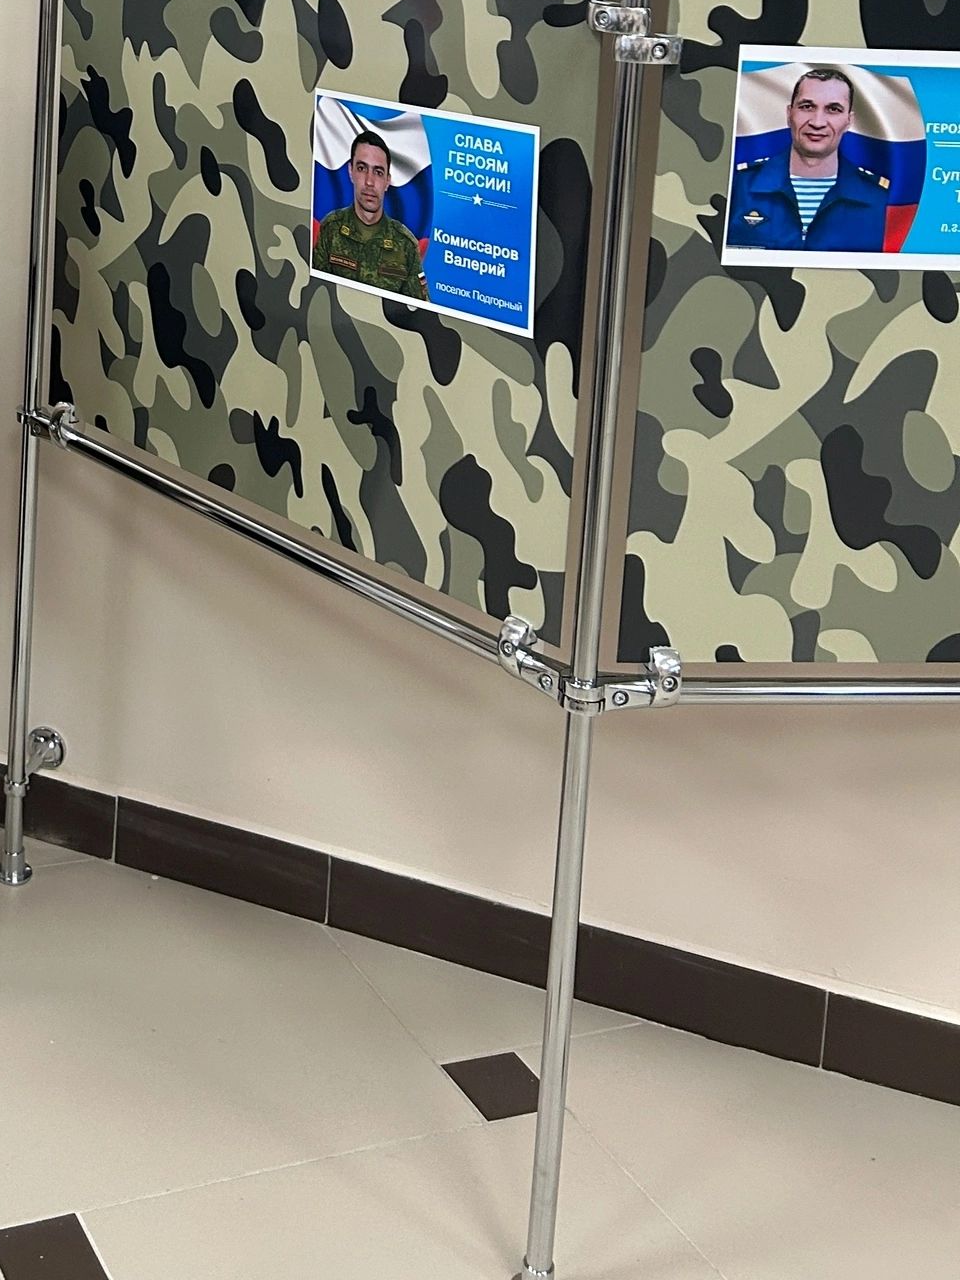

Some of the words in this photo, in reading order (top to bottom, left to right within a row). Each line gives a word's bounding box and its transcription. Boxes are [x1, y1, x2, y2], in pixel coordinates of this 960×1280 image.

[454, 133, 503, 155] СЛАВА
[448, 150, 509, 174] ГЕРОЯМ
[444, 167, 511, 194] РОССИИ!
[433, 227, 520, 261] Комиссаров
[443, 250, 506, 278] Валерий
[435, 281, 471, 299] поселок
[472, 289, 523, 312] Подгорный
